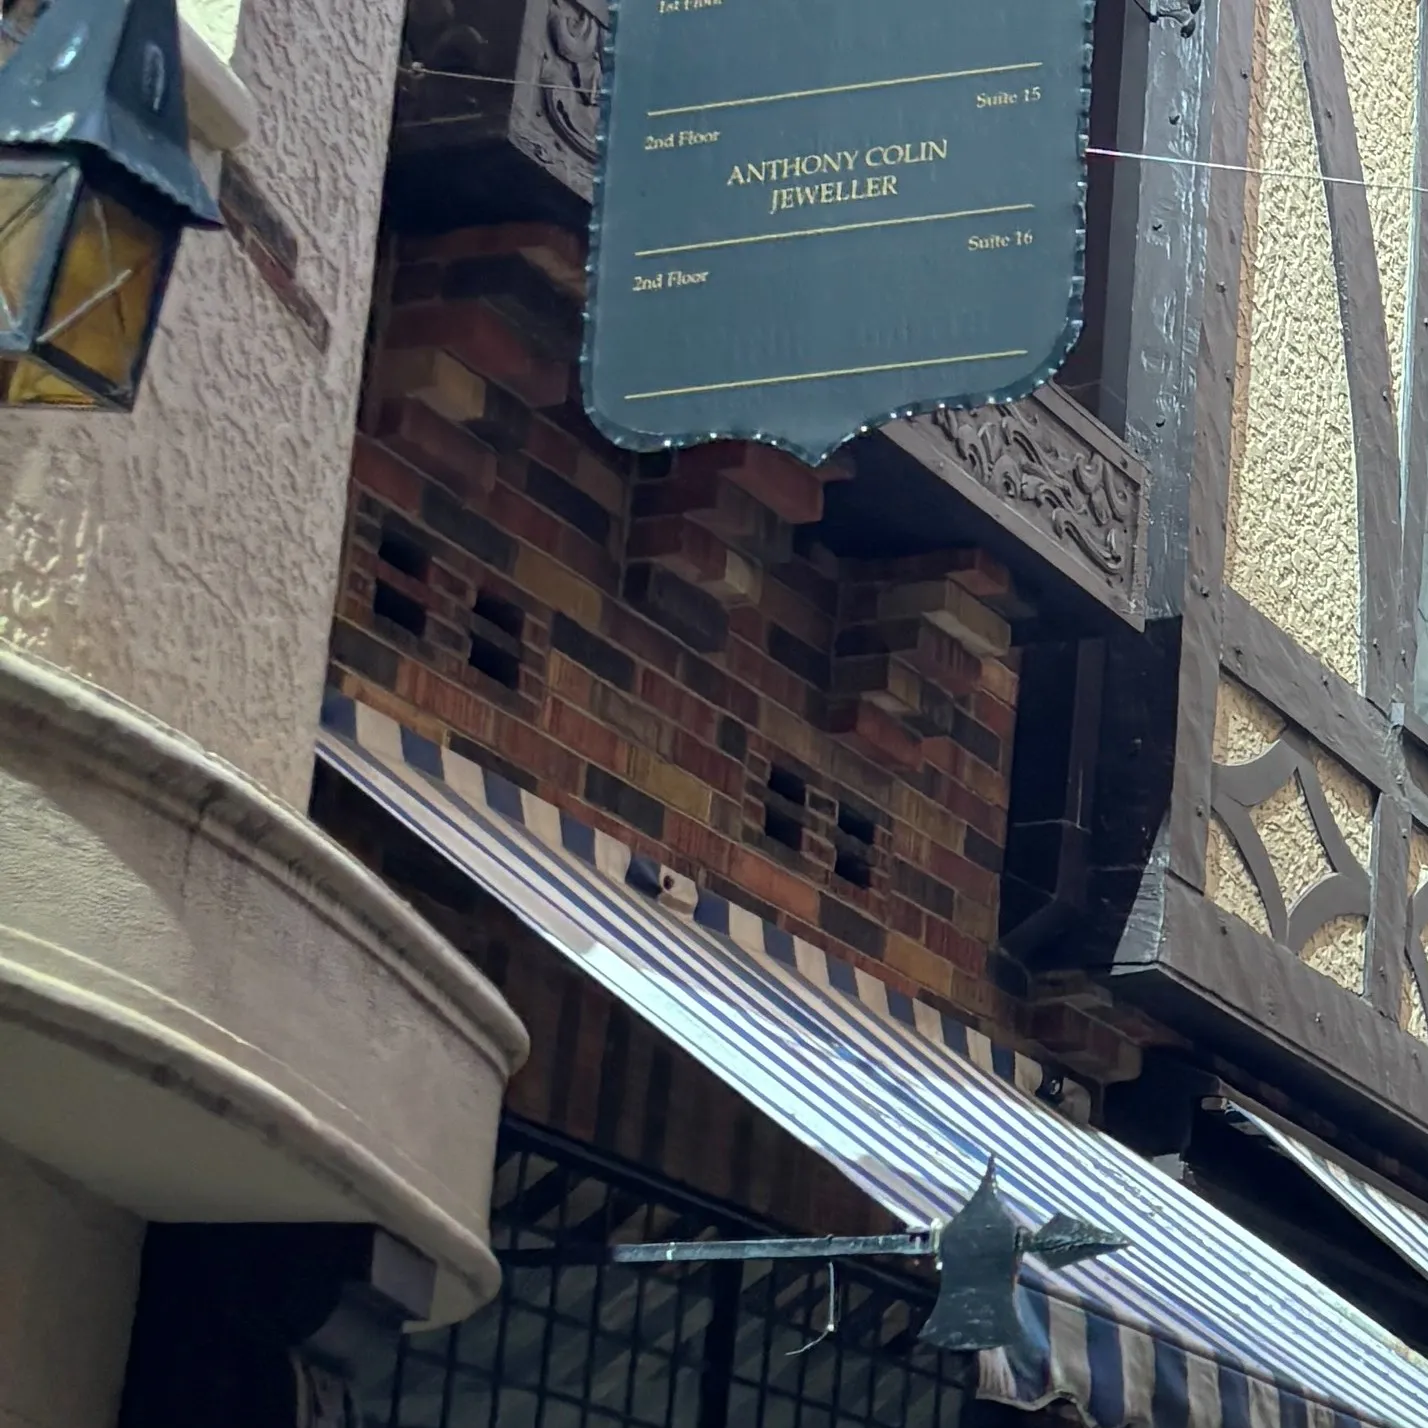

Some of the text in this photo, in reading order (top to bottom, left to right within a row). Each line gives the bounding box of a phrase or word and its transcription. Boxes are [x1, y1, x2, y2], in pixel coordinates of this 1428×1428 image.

[976, 86, 1042, 109] Suite 15
[644, 127, 721, 152] 2nd Floor
[726, 139, 949, 187] ANTHONY COLIN
[769, 176, 899, 214] JEWELLER
[968, 229, 1034, 253] Suite 16
[633, 267, 710, 293] 2nd Floor
